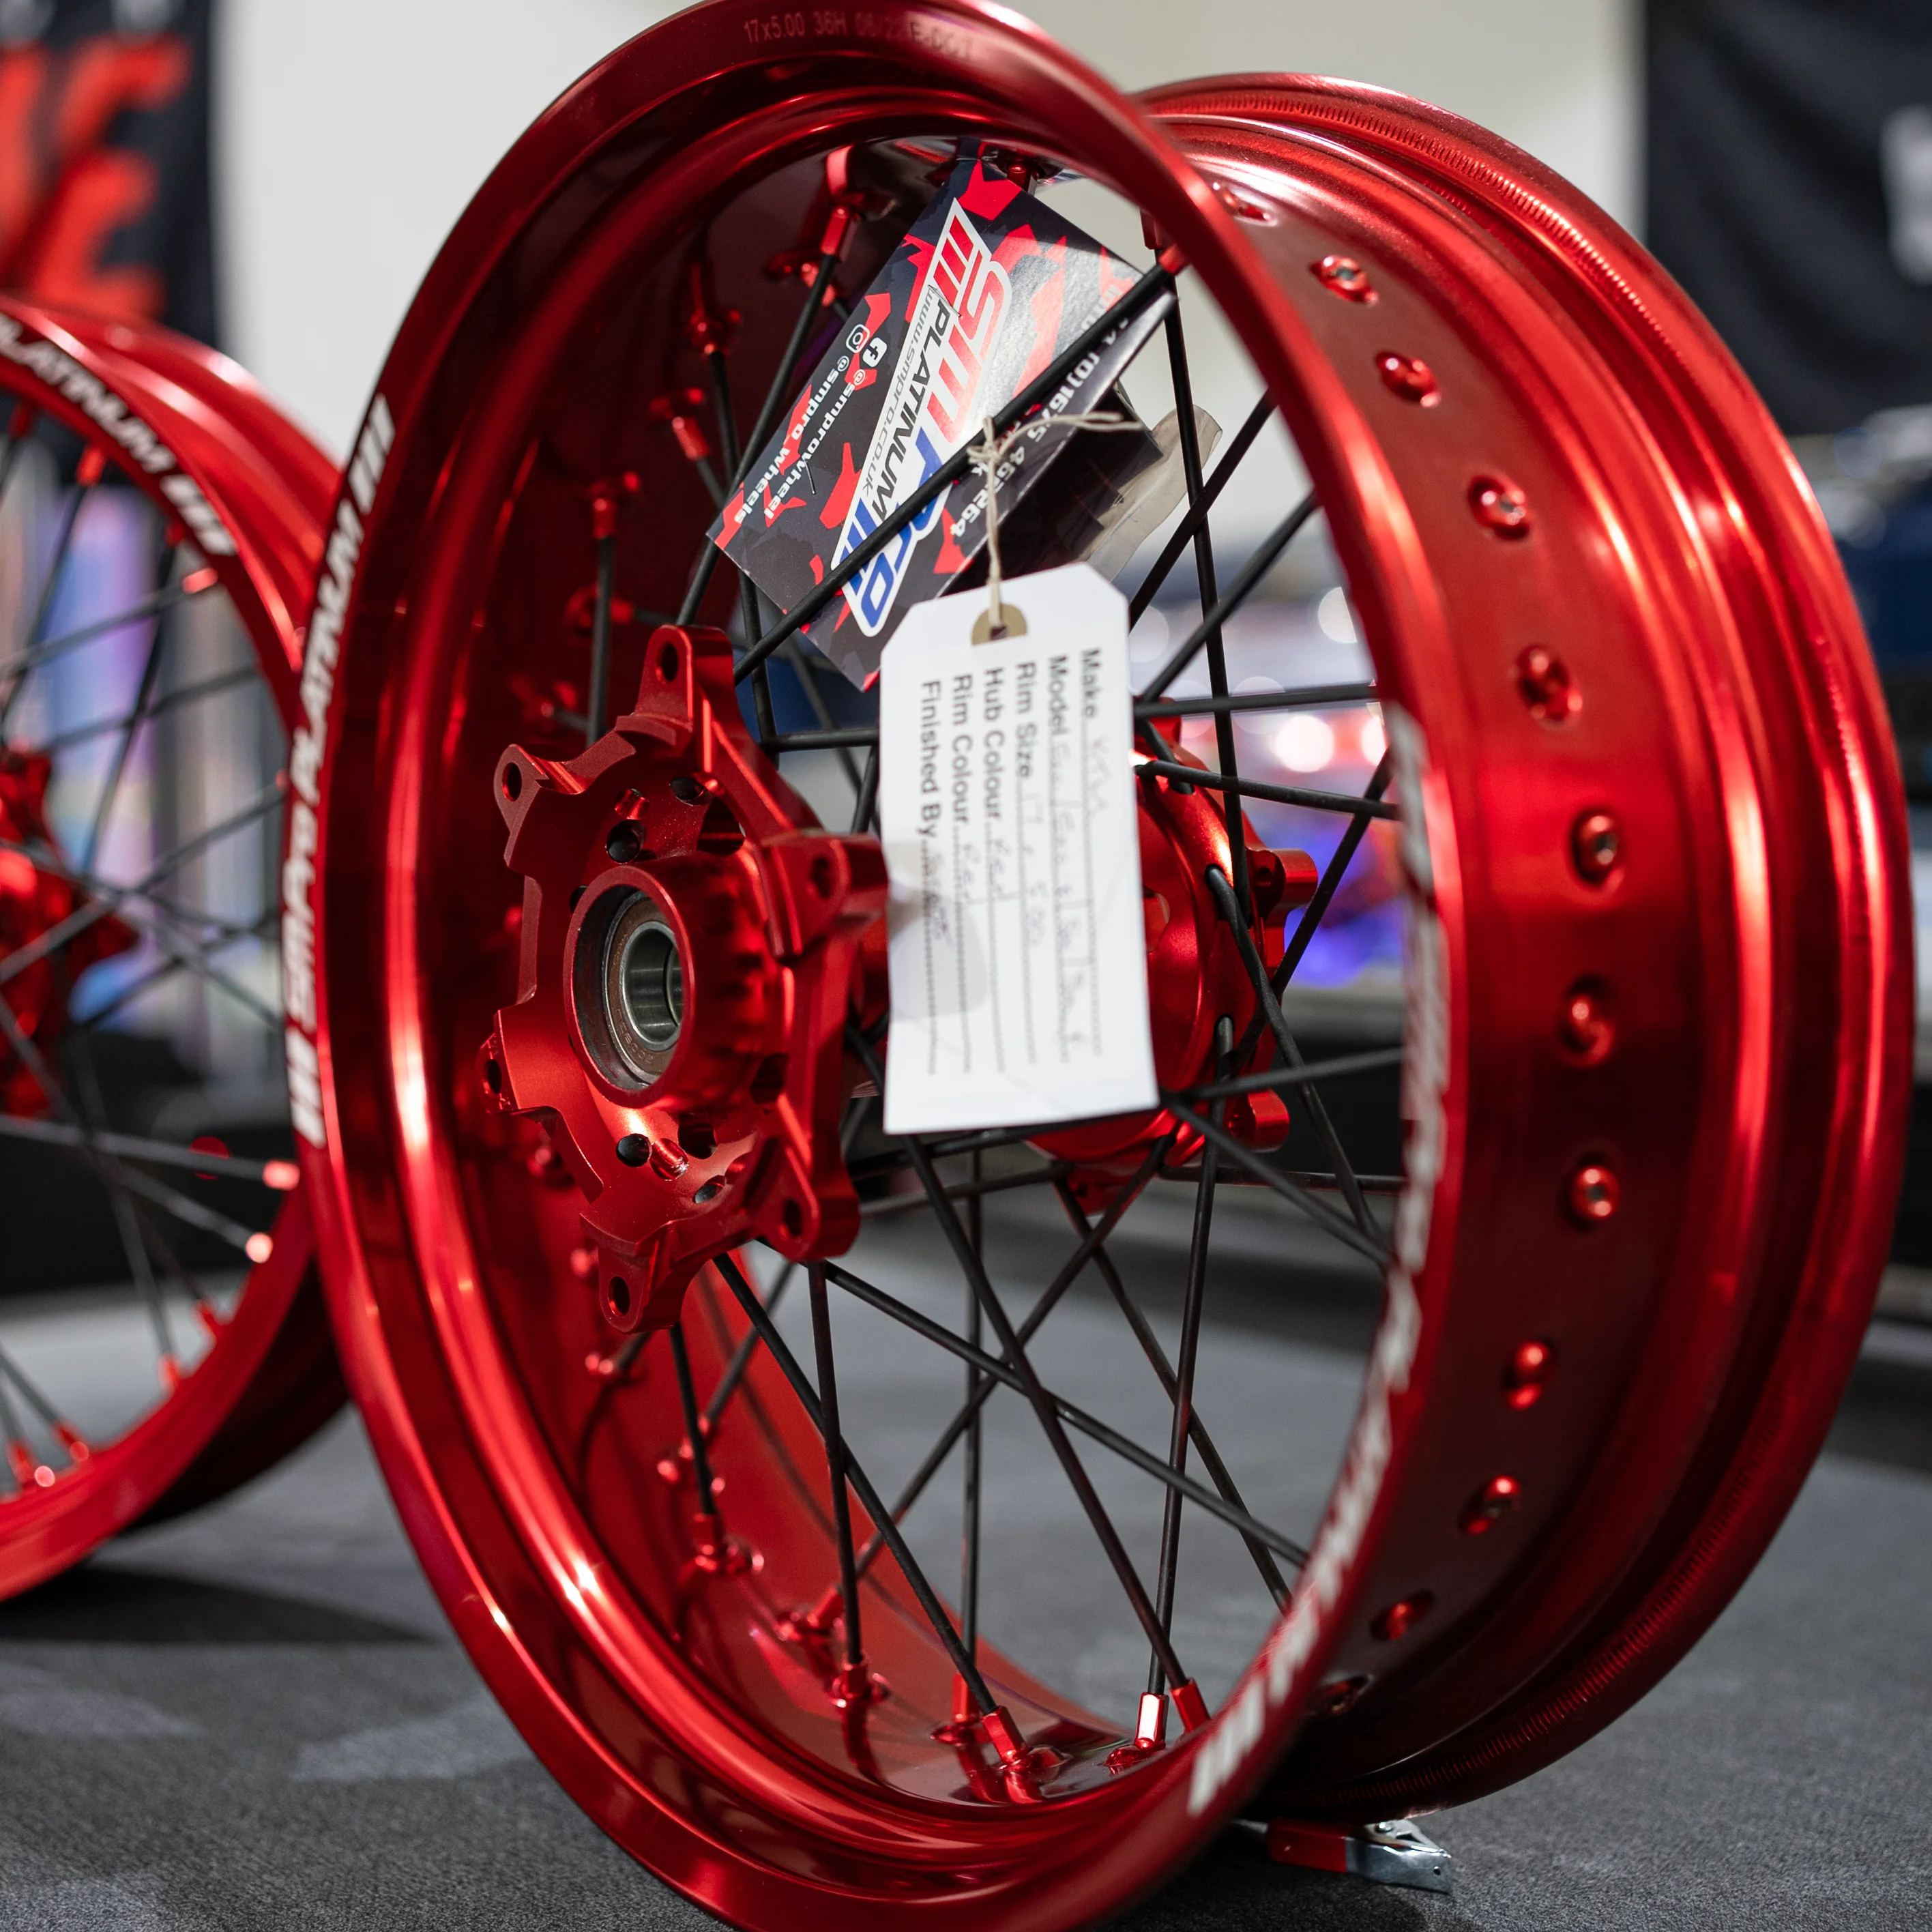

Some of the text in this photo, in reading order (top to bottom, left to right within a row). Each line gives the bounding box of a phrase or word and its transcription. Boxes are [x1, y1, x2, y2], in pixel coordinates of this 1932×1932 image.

[743, 12, 806, 44] 17x5.00
[733, 355, 850, 525] @smpro_wheels
[763, 368, 866, 520] @smprowheel
[861, 287, 938, 497] www.smpro.co.uk
[871, 297, 951, 525] PLATINUM
[916, 679, 942, 839] Finished By
[951, 673, 974, 825] Rim Colour
[982, 667, 1006, 820] Hub Colour
[1014, 660, 1038, 780] Rim Size
[1048, 654, 1070, 736] Model
[1081, 647, 1102, 719] Make
